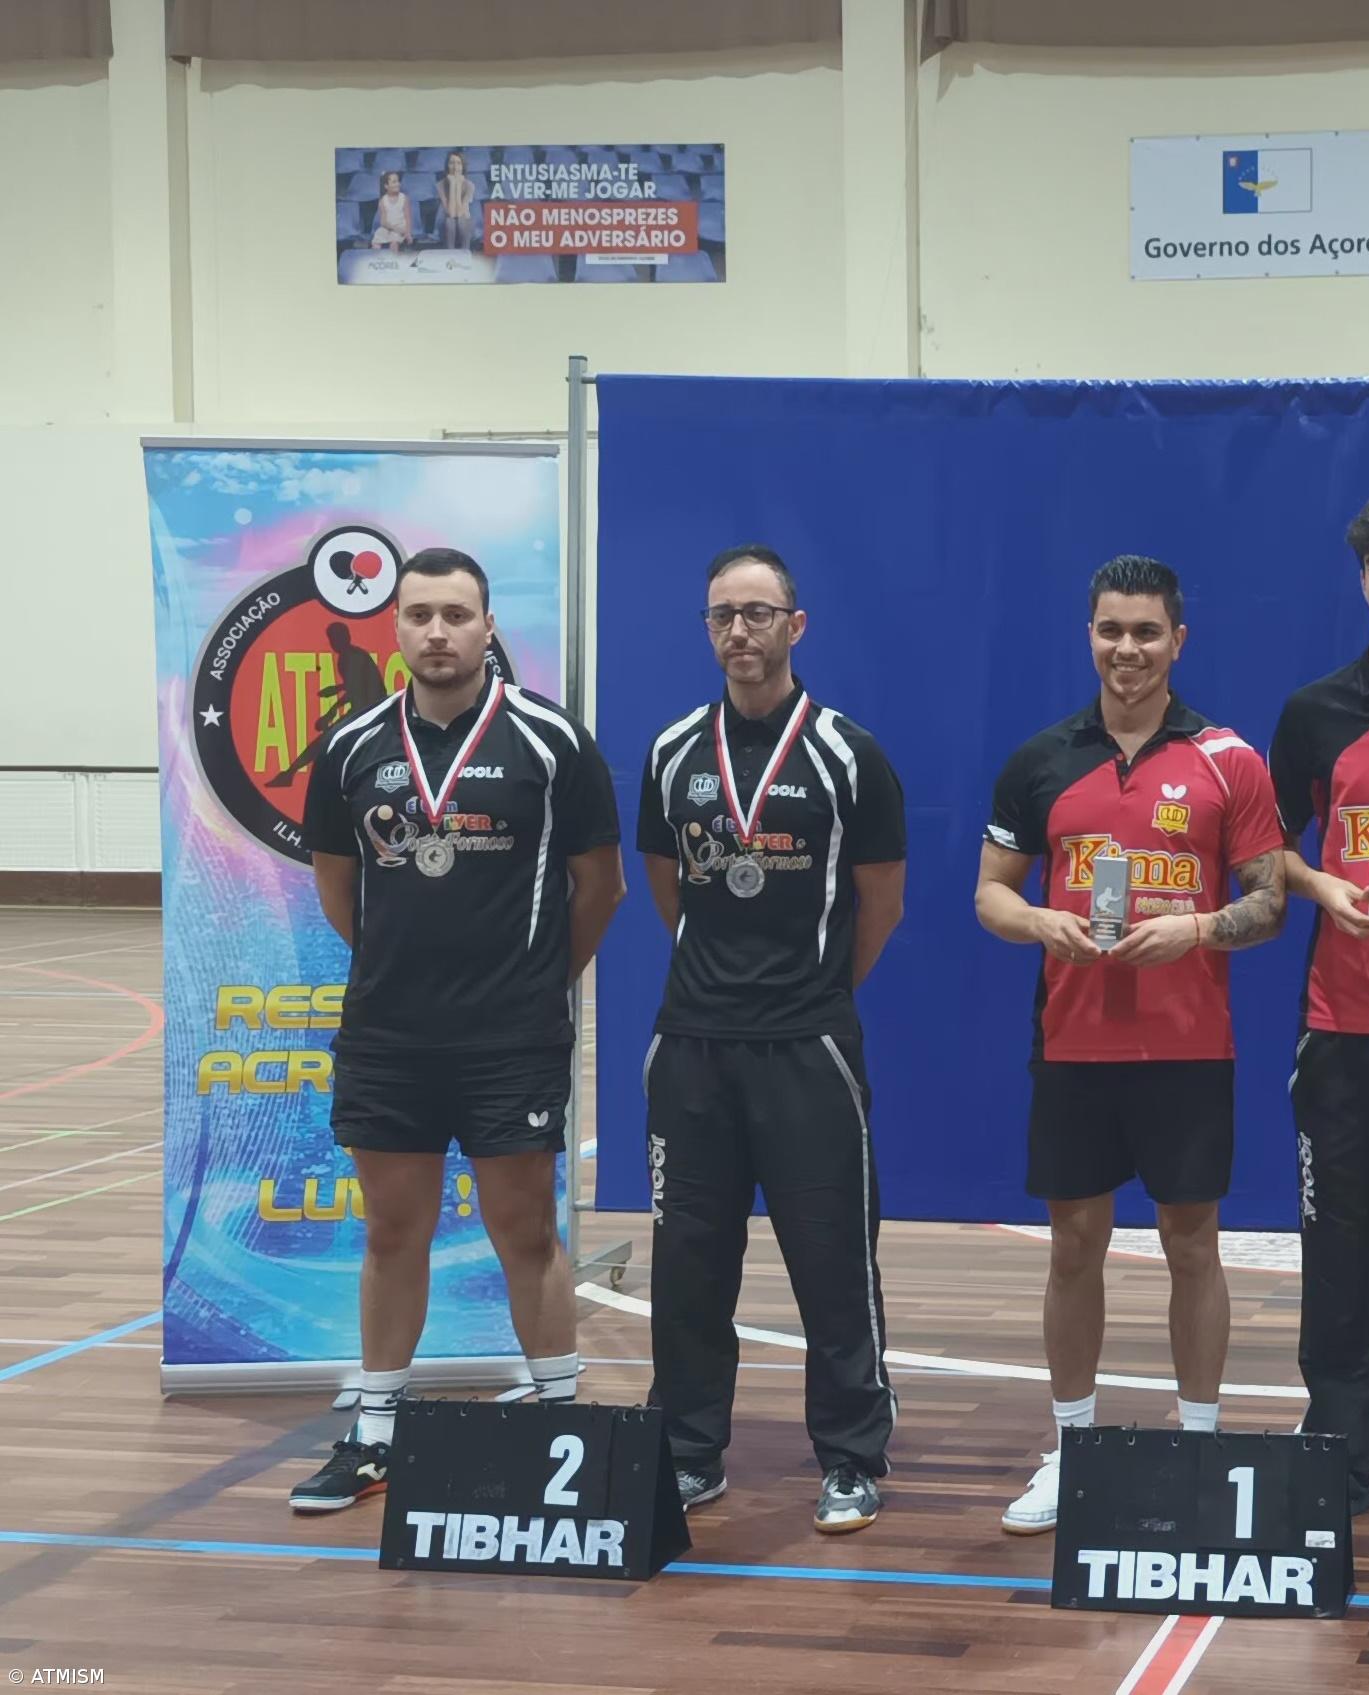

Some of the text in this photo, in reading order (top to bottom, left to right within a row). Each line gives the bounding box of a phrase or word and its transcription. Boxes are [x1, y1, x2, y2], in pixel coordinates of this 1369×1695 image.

[490, 164, 638, 181] ENTUSIASMA-TE
[490, 181, 657, 199] A VER-ME JOGAR
[490, 205, 679, 226] NÃO MENOSPREZES
[490, 226, 686, 248] O MEU ADVERSÁRIO
[1144, 237, 1250, 259] Governo
[1257, 233, 1301, 256] dos
[209, 592, 281, 681] ASSOCIAÇÃO
[766, 784, 807, 798] OOLA
[273, 821, 302, 848] ILH
[544, 1434, 585, 1506] 2
[1227, 1466, 1255, 1539] 1
[406, 1511, 626, 1567] TIBHAR
[1077, 1549, 1315, 1606] TIBHAR
